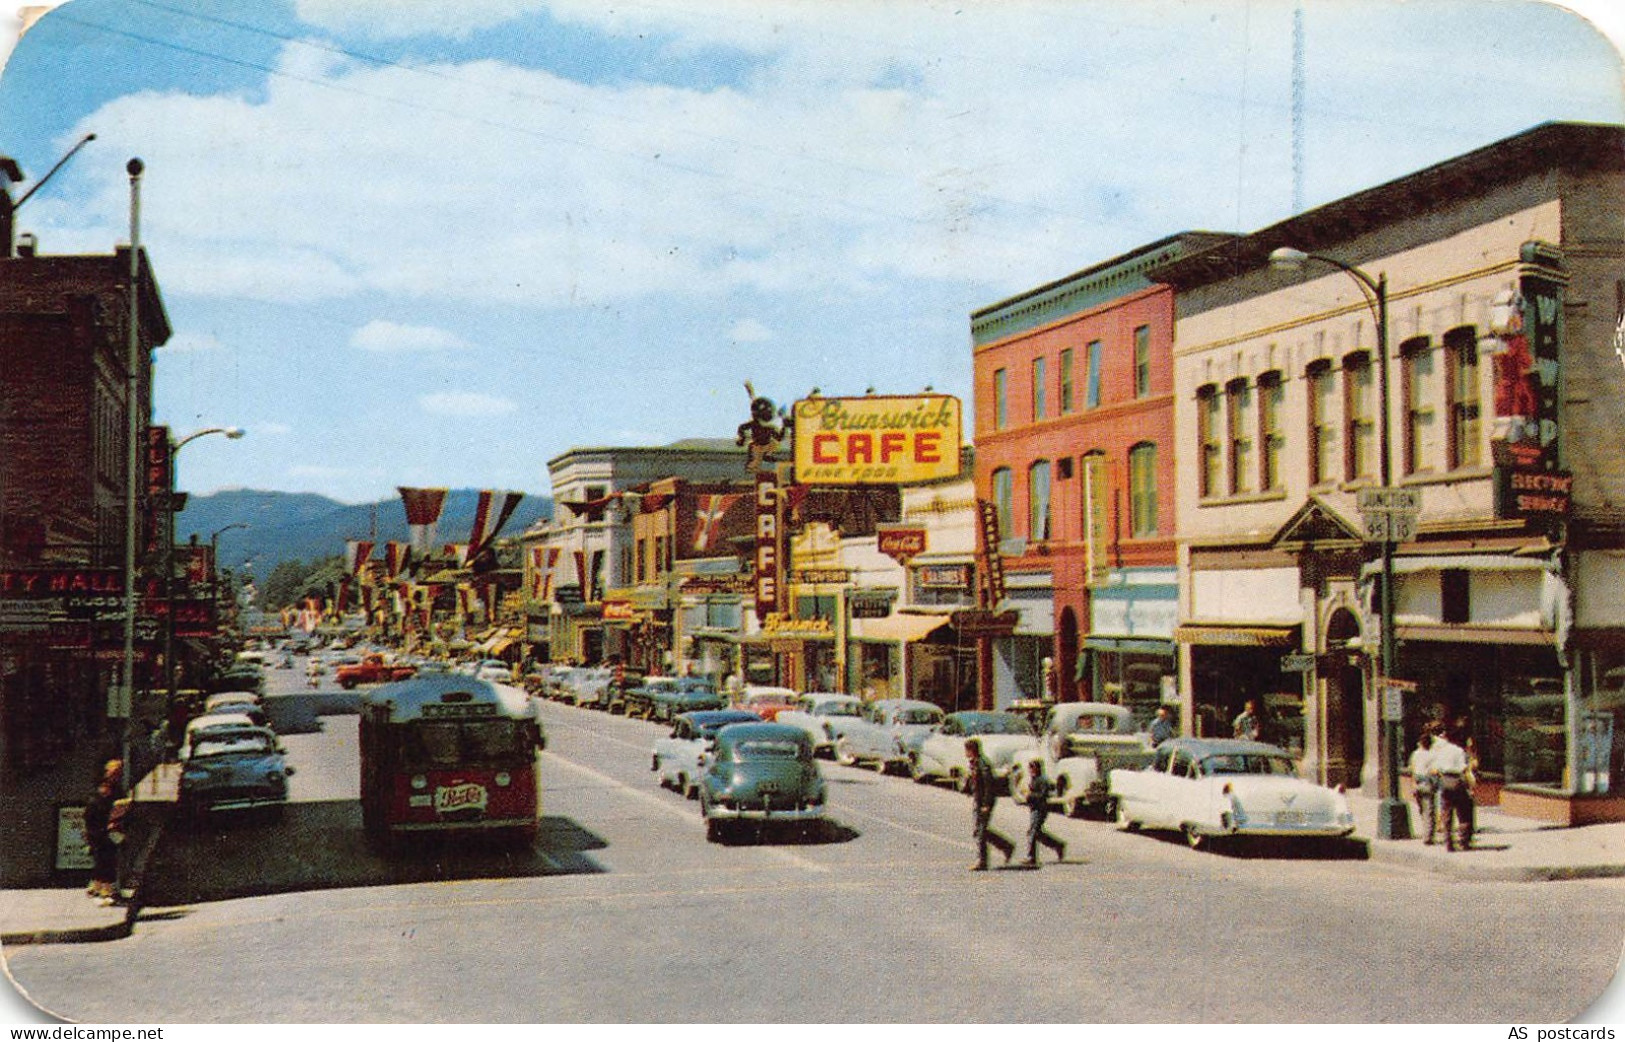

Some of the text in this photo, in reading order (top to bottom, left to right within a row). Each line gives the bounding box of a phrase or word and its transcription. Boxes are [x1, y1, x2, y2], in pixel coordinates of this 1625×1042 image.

[800, 398, 953, 430] Brunswick
[812, 432, 942, 464] CAFE
[803, 466, 898, 479] FINE FOOD
[1368, 523, 1384, 538] 95
[1397, 523, 1410, 538] 10
[757, 482, 776, 601] CAFE
[52, 573, 121, 591] HALL
